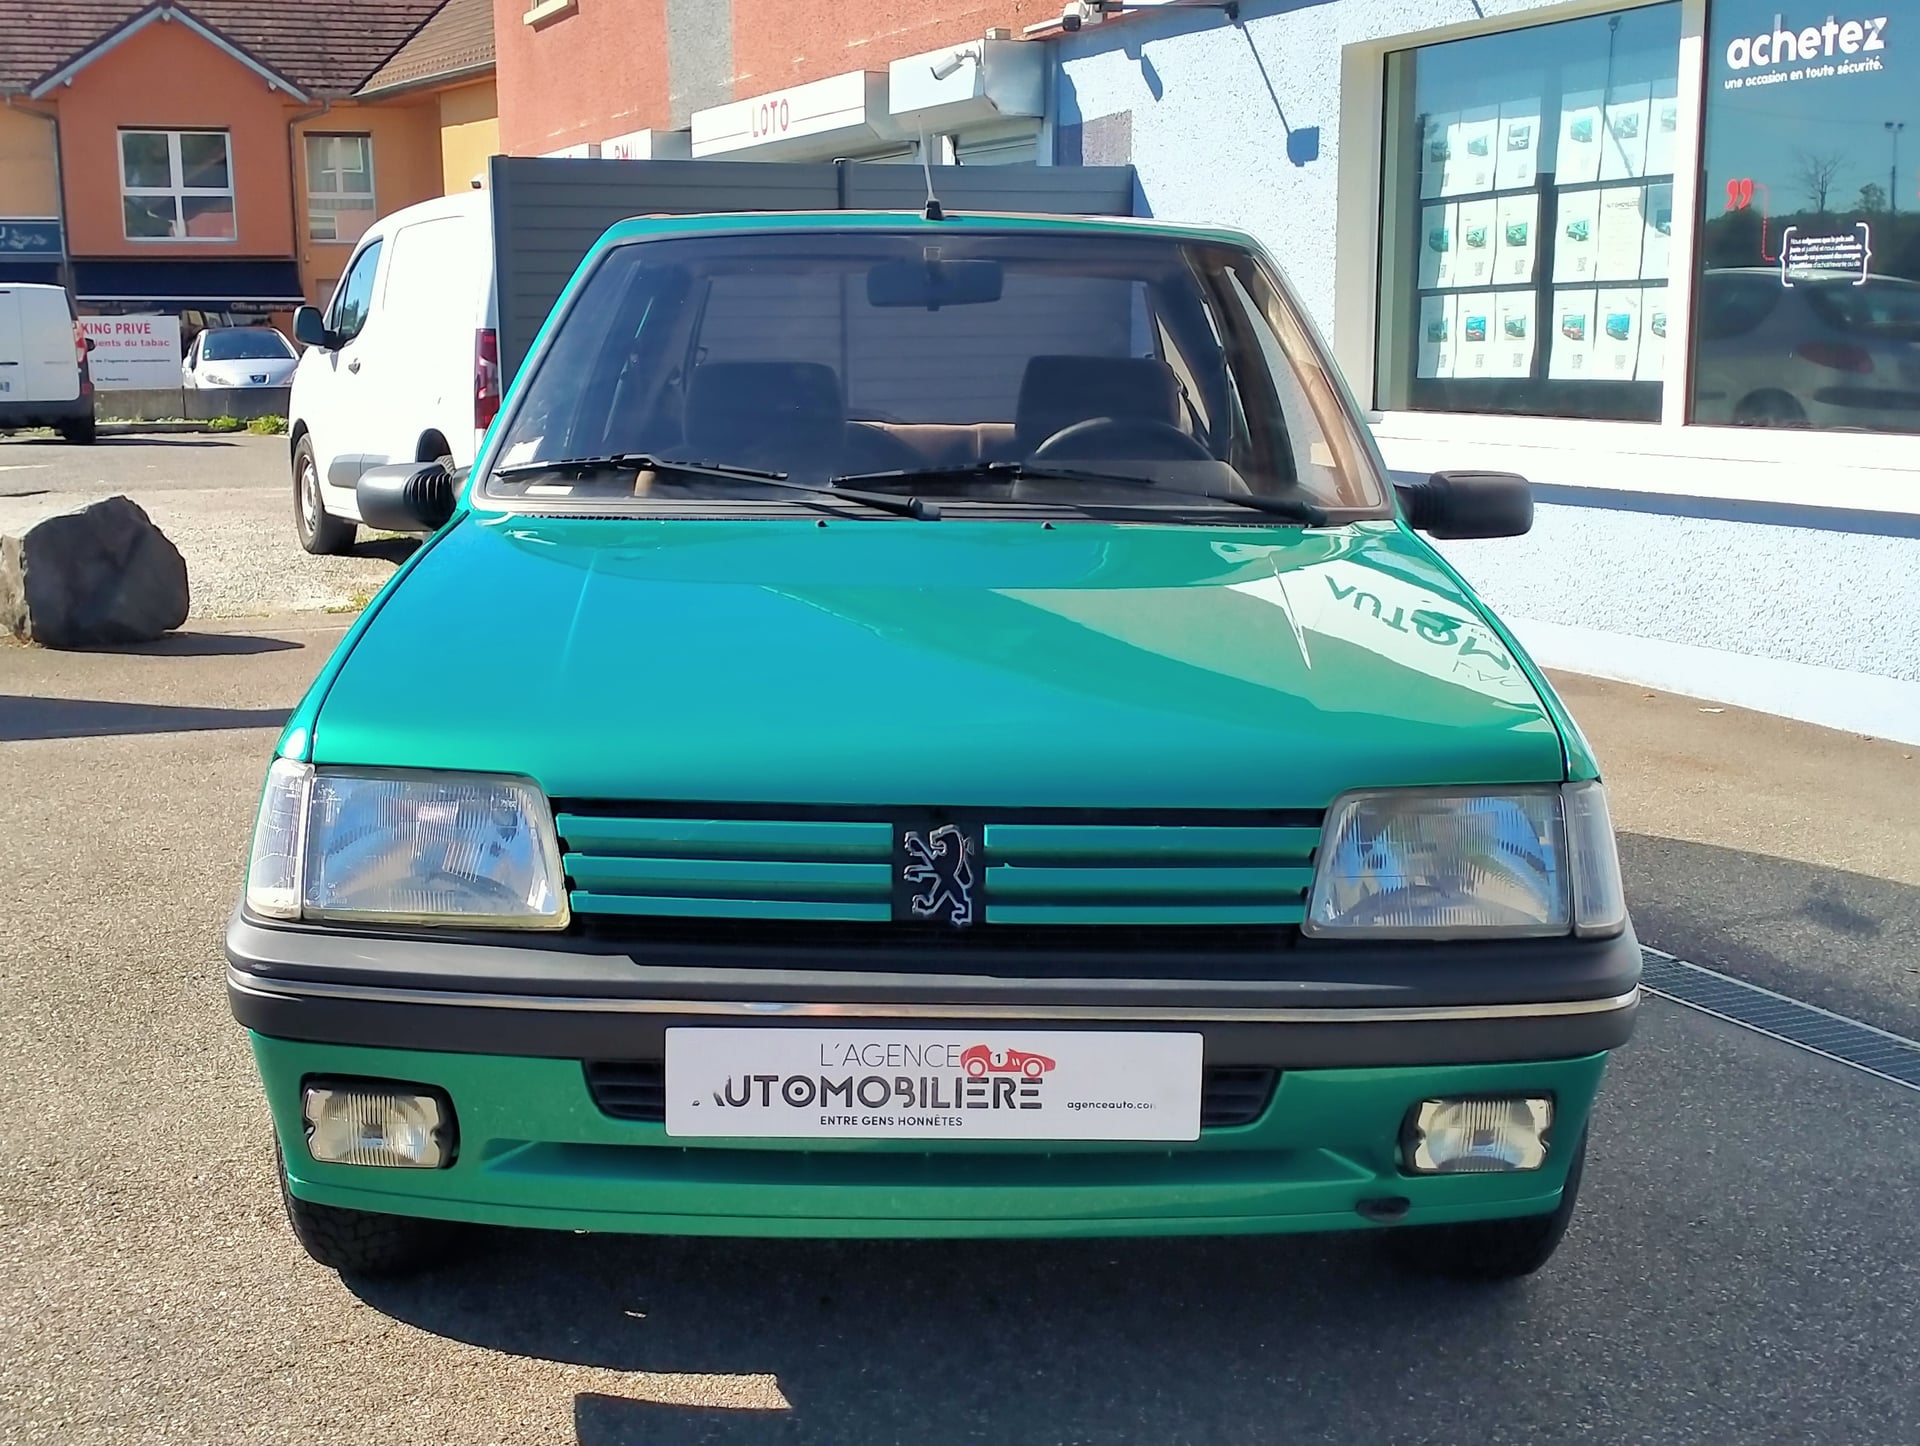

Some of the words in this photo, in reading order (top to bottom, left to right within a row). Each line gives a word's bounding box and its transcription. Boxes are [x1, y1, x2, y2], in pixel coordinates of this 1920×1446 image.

[1726, 13, 1888, 70] achetez
[1724, 78, 1743, 89] une
[1745, 70, 1788, 87] occasion
[1790, 71, 1803, 81] en
[1805, 64, 1835, 79] toute
[1837, 55, 1883, 75] sécurité.
[751, 98, 789, 138] LOTO
[124, 339, 137, 347] du
[141, 339, 170, 347] tabac
[820, 1043, 961, 1068] L'AGENCE
[820, 1116, 858, 1126] ENTRE
[862, 1116, 894, 1126] GENS
[898, 1114, 963, 1127] HONNÊTES
